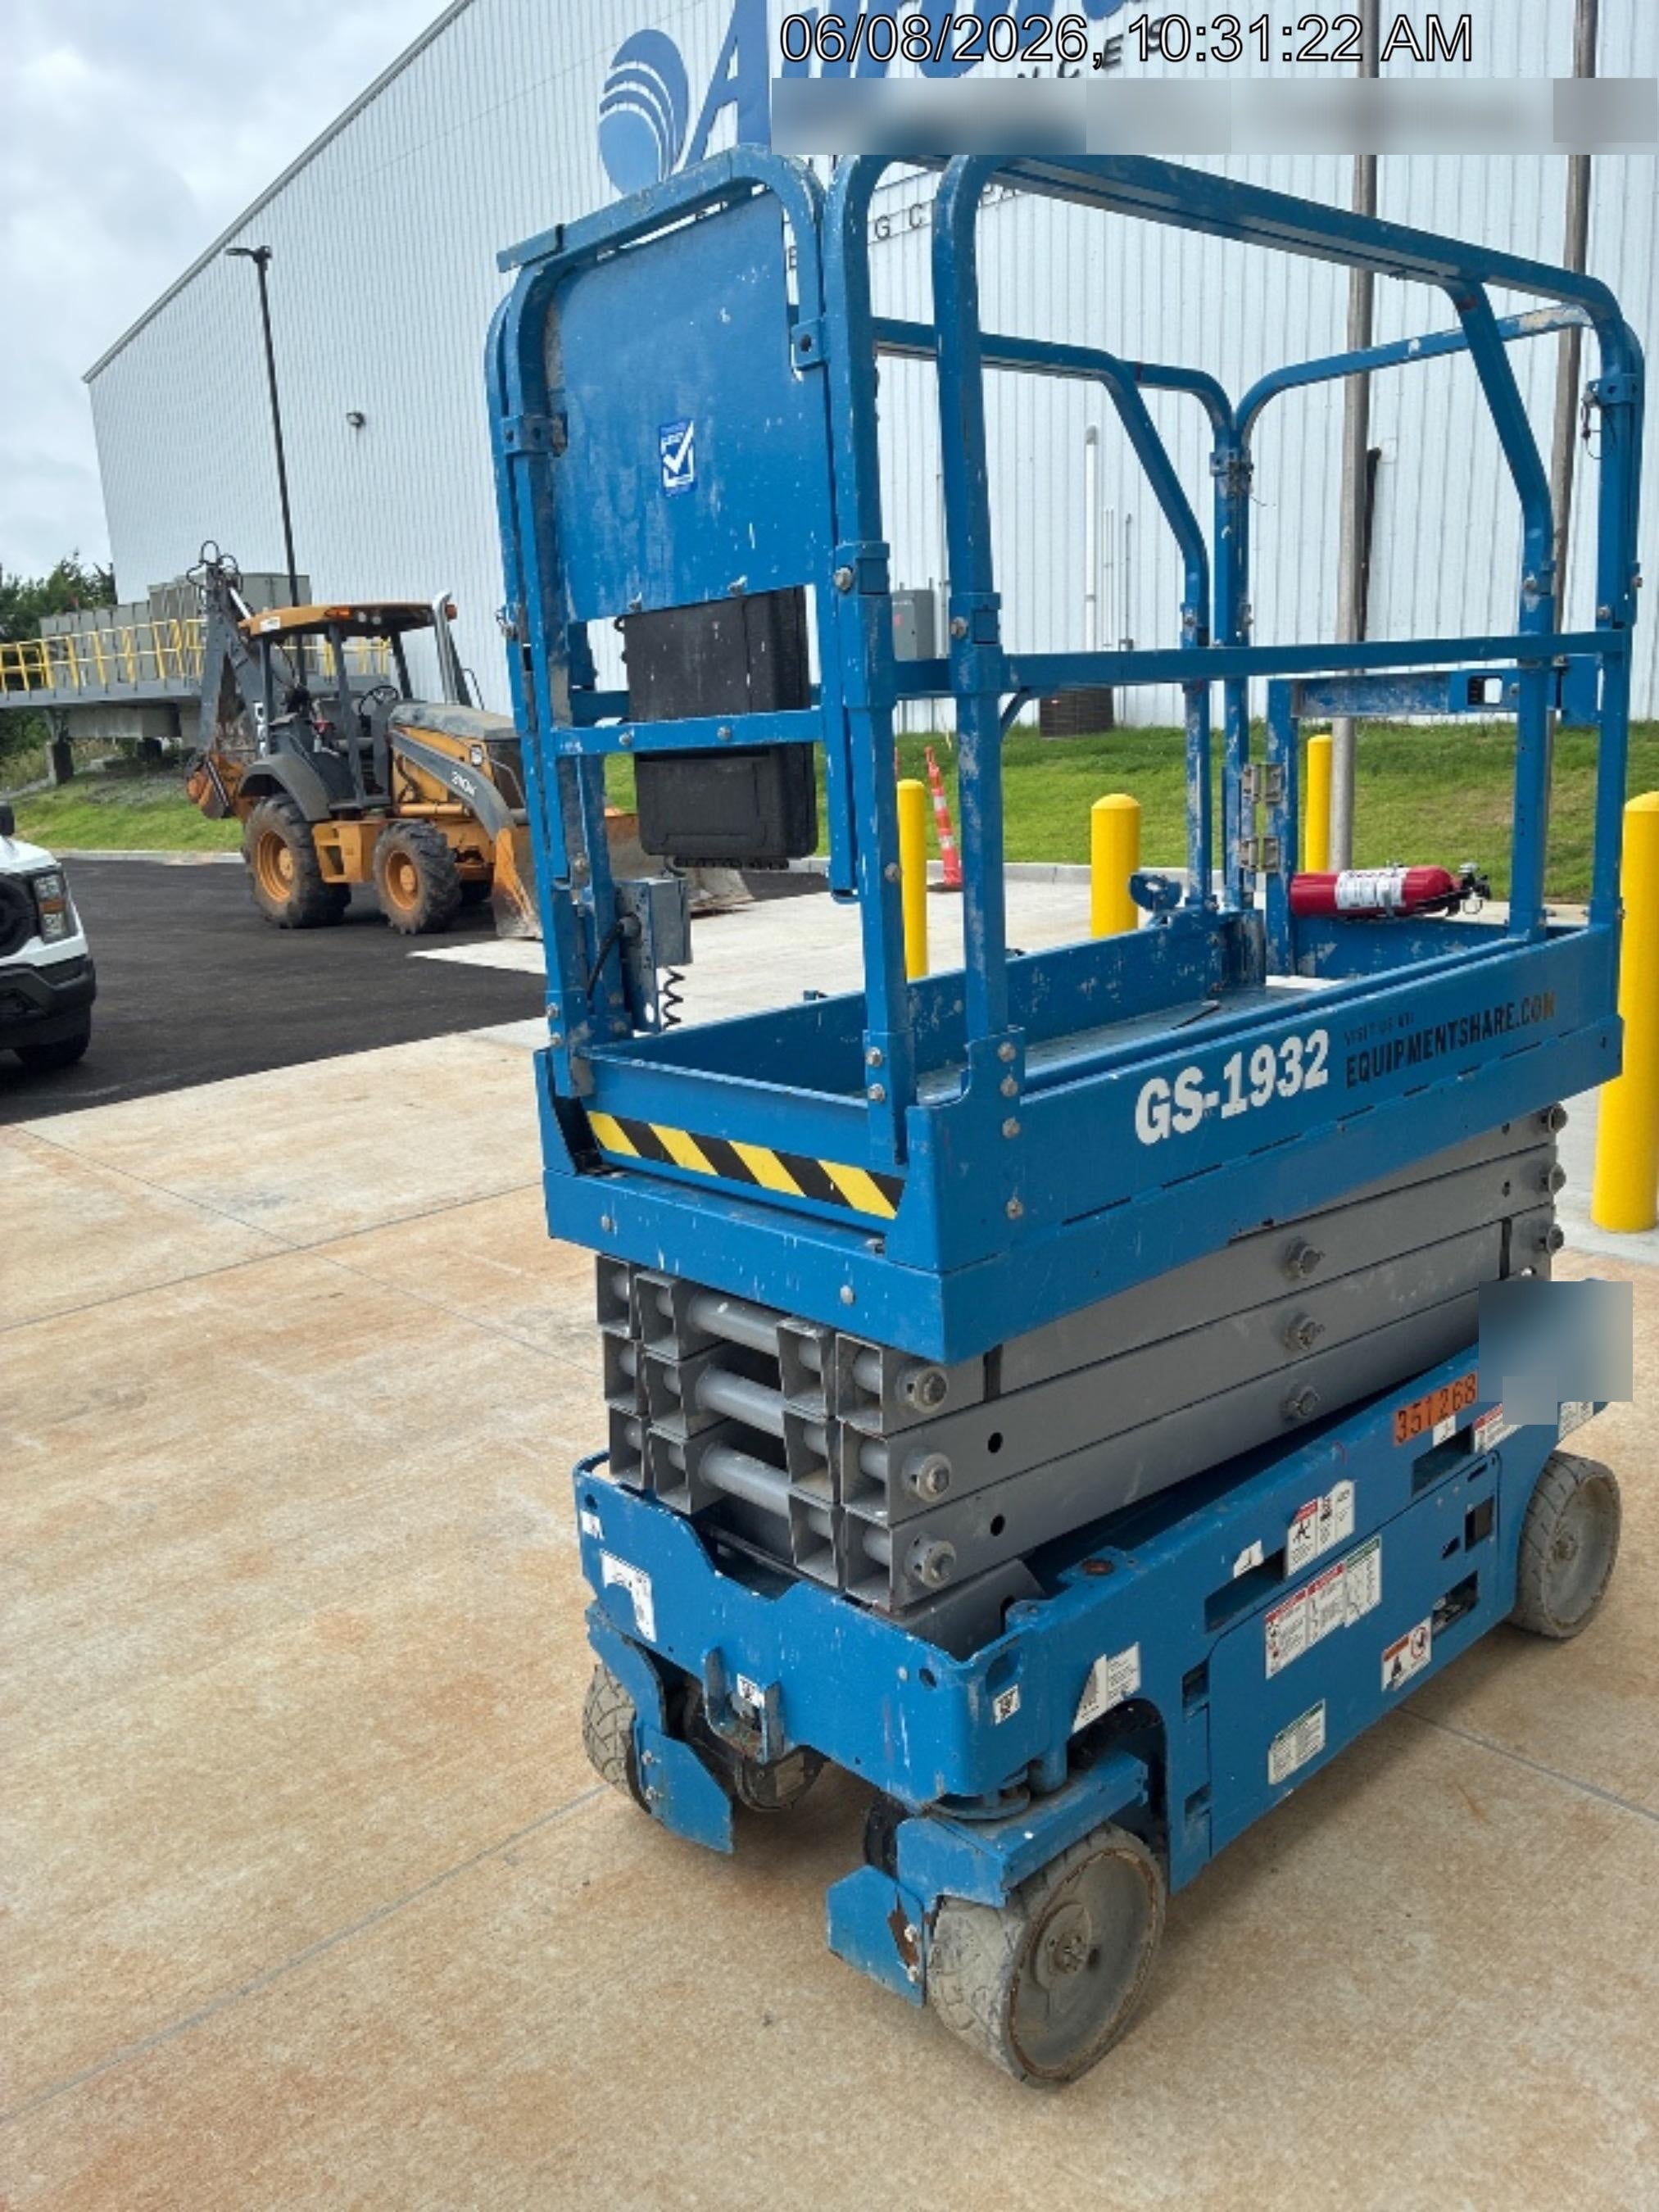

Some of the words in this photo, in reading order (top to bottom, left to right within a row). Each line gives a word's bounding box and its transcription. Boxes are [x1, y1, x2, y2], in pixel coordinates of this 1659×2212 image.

[1135, 1029, 1329, 1145] GS-1932
[1346, 990, 1556, 1089] EQUIPMENTSHARE.COM
[1395, 1372, 1476, 1444] 351268
